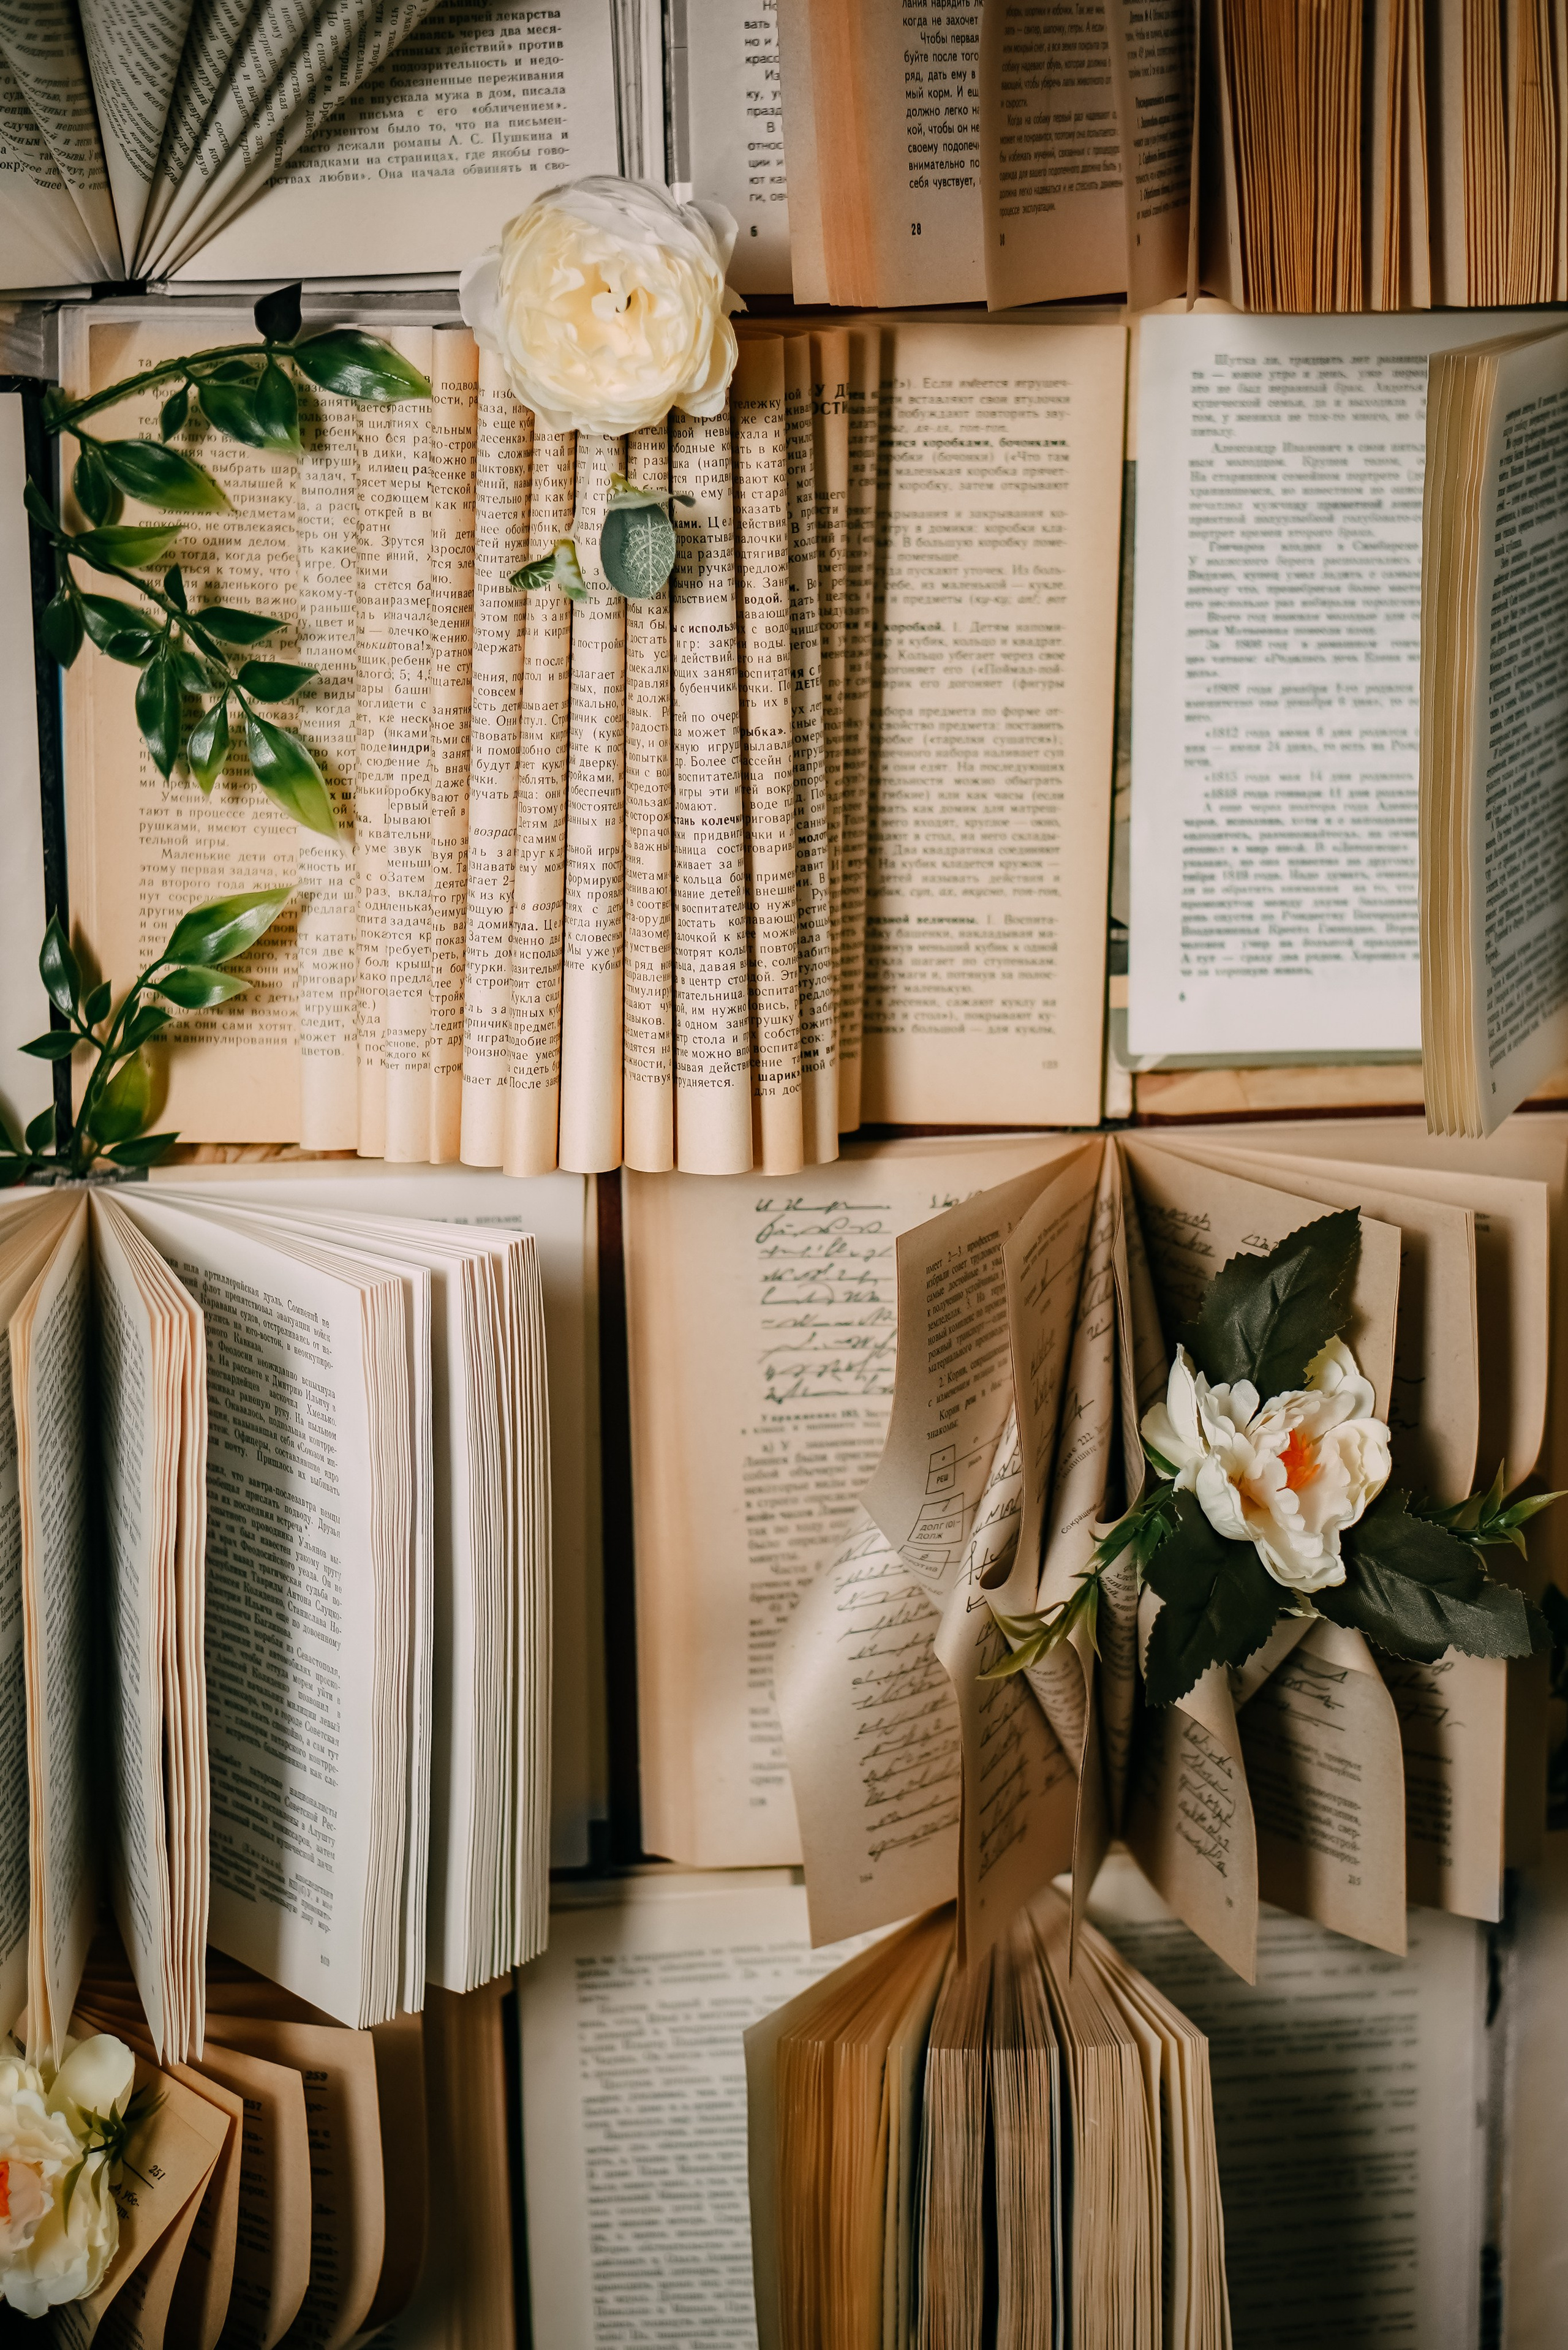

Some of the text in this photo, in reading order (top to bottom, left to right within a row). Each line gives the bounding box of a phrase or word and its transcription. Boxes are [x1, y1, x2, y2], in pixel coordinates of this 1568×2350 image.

[903, 17, 927, 28] когда
[946, 17, 978, 25] захочет
[921, 31, 979, 46] Чтобы первая
[904, 50, 928, 65] буйте
[905, 72, 923, 84] ряд,
[928, 71, 946, 81] дать
[951, 70, 967, 81] ему
[371, 94, 428, 105] впускала
[435, 92, 469, 102] мужа
[489, 90, 515, 99] дом,
[522, 87, 565, 96] писала
[906, 86, 963, 100] мый корм. И
[907, 107, 968, 119] должно легко
[1008, 111, 1051, 127] Когда собаку
[388, 123, 420, 133] было
[509, 118, 567, 127] письмен-
[907, 124, 925, 136] кой,
[929, 121, 954, 134] чтобы
[393, 139, 440, 151] романы
[449, 135, 462, 145] А.
[470, 134, 483, 145] С.
[492, 132, 552, 145] Пушкина
[388, 153, 458, 165] страницах,
[466, 151, 485, 160] где
[492, 146, 530, 158] якобы
[908, 144, 938, 154] своему
[379, 168, 402, 179] Она
[412, 168, 454, 177] начала
[463, 164, 522, 175] обвинять
[909, 160, 965, 170] внимательно
[910, 176, 975, 189] себя чувствует,
[911, 223, 921, 235] 28
[494, 421, 515, 429] еще
[481, 435, 527, 443] лесенка».
[213, 464, 265, 475] выбрать
[233, 495, 295, 506] признаку.
[226, 553, 260, 562] когда
[745, 593, 782, 605] водой.
[677, 640, 699, 651] игр:
[754, 639, 785, 649] воды.
[681, 650, 734, 663] действий.
[478, 688, 516, 696] совсем
[497, 715, 516, 726] Они
[477, 759, 510, 773] будут
[579, 759, 618, 770] дверку.
[691, 756, 726, 766] Более
[571, 785, 621, 797] обеспечить
[680, 789, 701, 799] игры
[519, 802, 557, 816] Поэтому
[750, 799, 777, 810] воде
[190, 810, 244, 820] процессе
[196, 838, 228, 848] игры.
[162, 848, 230, 860] Маленькие
[599, 846, 619, 858] игры
[181, 866, 224, 876] первая
[684, 876, 722, 885] кольца
[678, 919, 715, 928] достать
[469, 930, 502, 943] Затем
[568, 943, 609, 959] Мы уже
[635, 961, 653, 971] ряд
[690, 978, 721, 989] центр
[511, 990, 540, 1004] Кукла
[712, 1004, 746, 1017] нужно
[301, 1019, 344, 1028] следит,
[514, 1022, 556, 1034] предмет,
[685, 1021, 717, 1030] одном
[301, 1047, 344, 1057] цветов.
[510, 1076, 541, 1089] После
[926, 1259, 944, 1276] имеет
[927, 1270, 951, 1289] избрали
[263, 1292, 318, 1324] дуэль. Сомнений
[241, 1310, 310, 1346] судов, отстреливаясь
[928, 1328, 947, 1346] новый
[302, 1376, 335, 1399] вспыхнула
[307, 1404, 336, 1426] Хмелько.
[275, 1406, 336, 1440] руку. пыльном
[937, 1474, 948, 1484] РЕШ
[311, 1476, 339, 1496] выбивать
[318, 1517, 341, 1537] Друзья
[920, 1523, 944, 1531] ДОЛГ
[298, 1535, 326, 1558] Ульянов
[323, 1565, 341, 1581] кругу
[287, 1587, 312, 1607] Антона
[306, 1583, 328, 1600] судьба
[288, 1600, 326, 1628] Станислава
[303, 1624, 341, 1651] довоенному
[149, 2165, 165, 2180] 251
